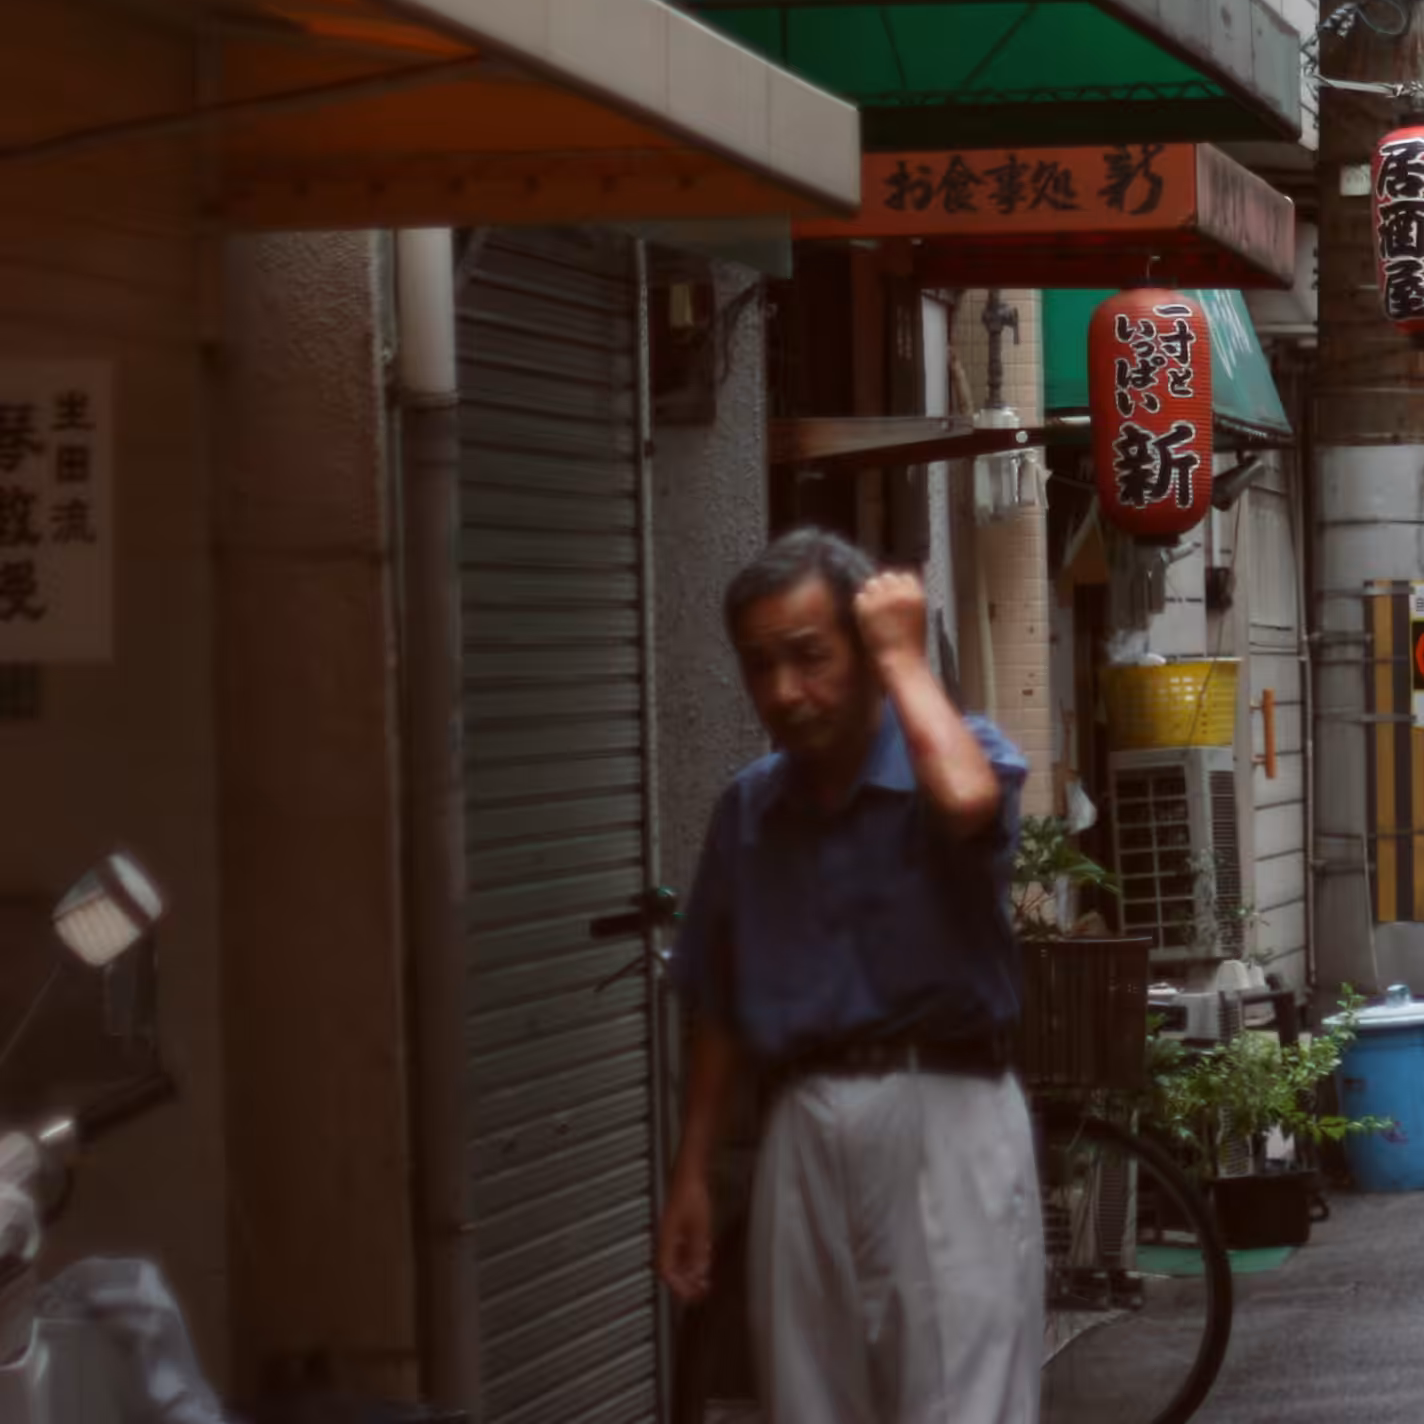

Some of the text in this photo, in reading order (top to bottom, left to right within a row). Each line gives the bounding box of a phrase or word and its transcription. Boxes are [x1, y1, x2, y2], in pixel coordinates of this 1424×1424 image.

[885, 143, 1166, 217] お食事処 新
[1114, 313, 1168, 418] いっぱい
[1152, 303, 1197, 398] 一寸と
[1112, 419, 1200, 511] 新
